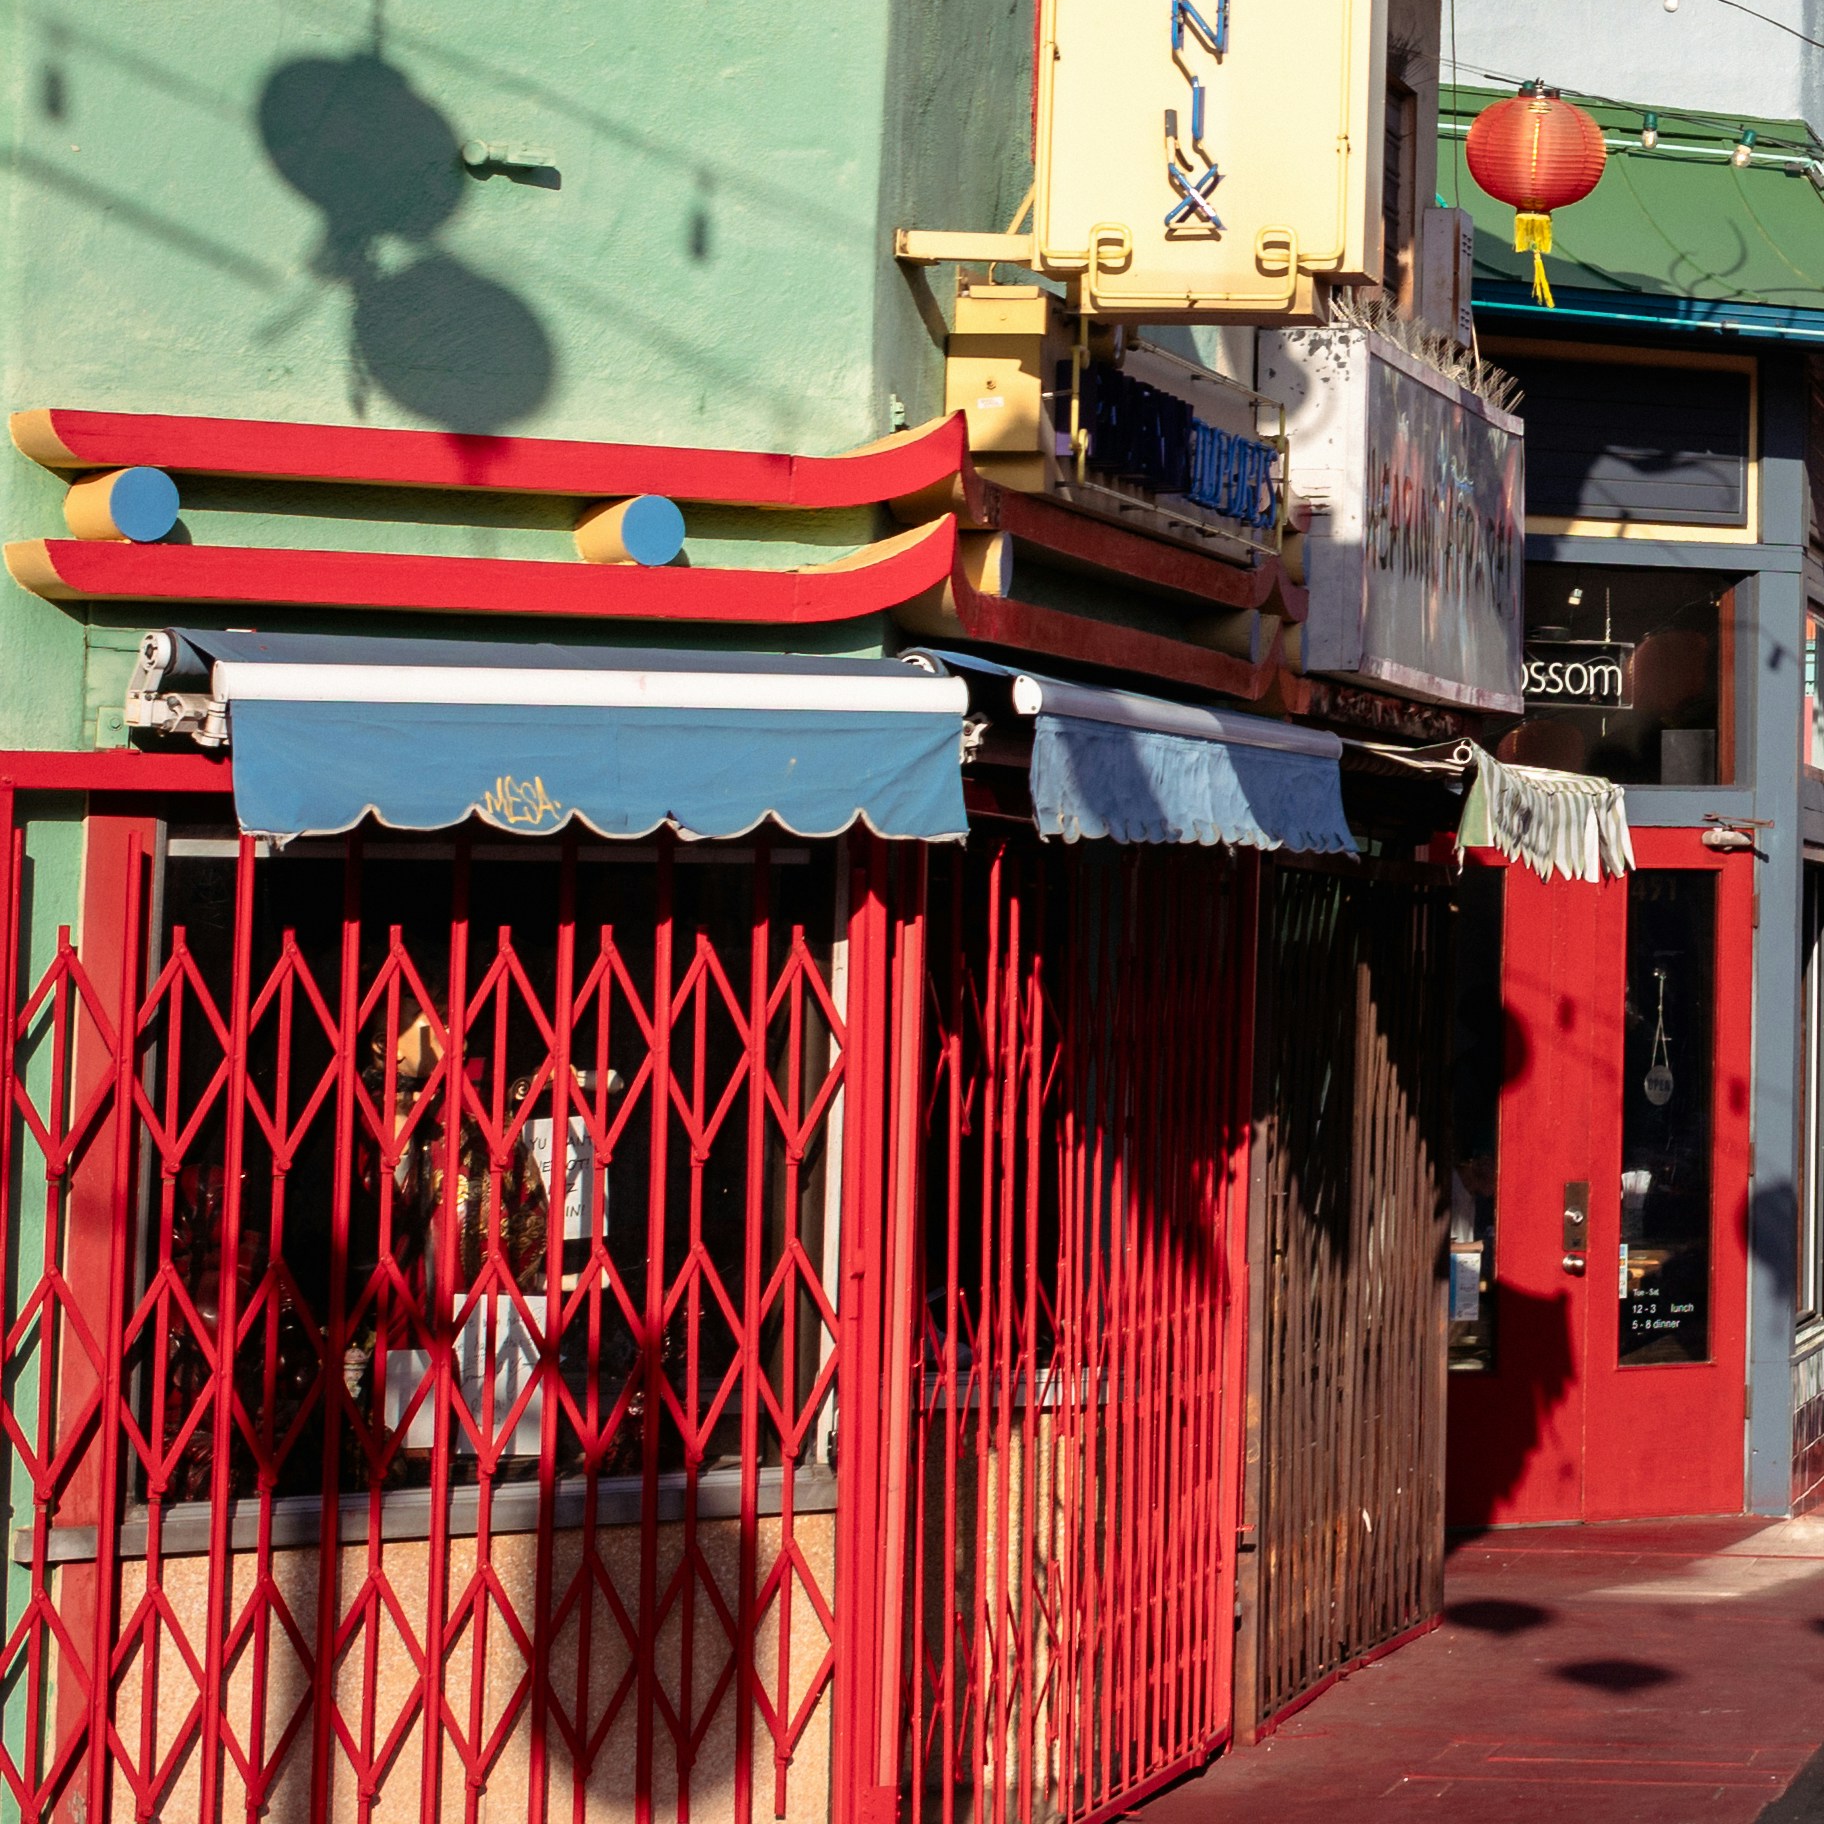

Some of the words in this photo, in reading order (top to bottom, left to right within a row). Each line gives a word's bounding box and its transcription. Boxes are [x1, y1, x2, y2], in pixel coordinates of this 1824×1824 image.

[1632, 1304, 1643, 1314] 12
[1649, 1304, 1657, 1314] 3
[1670, 1303, 1695, 1313] lunch
[1631, 1319, 1639, 1330] 5
[1645, 1319, 1652, 1329] 8
[1652, 1318, 1681, 1329] dinner
